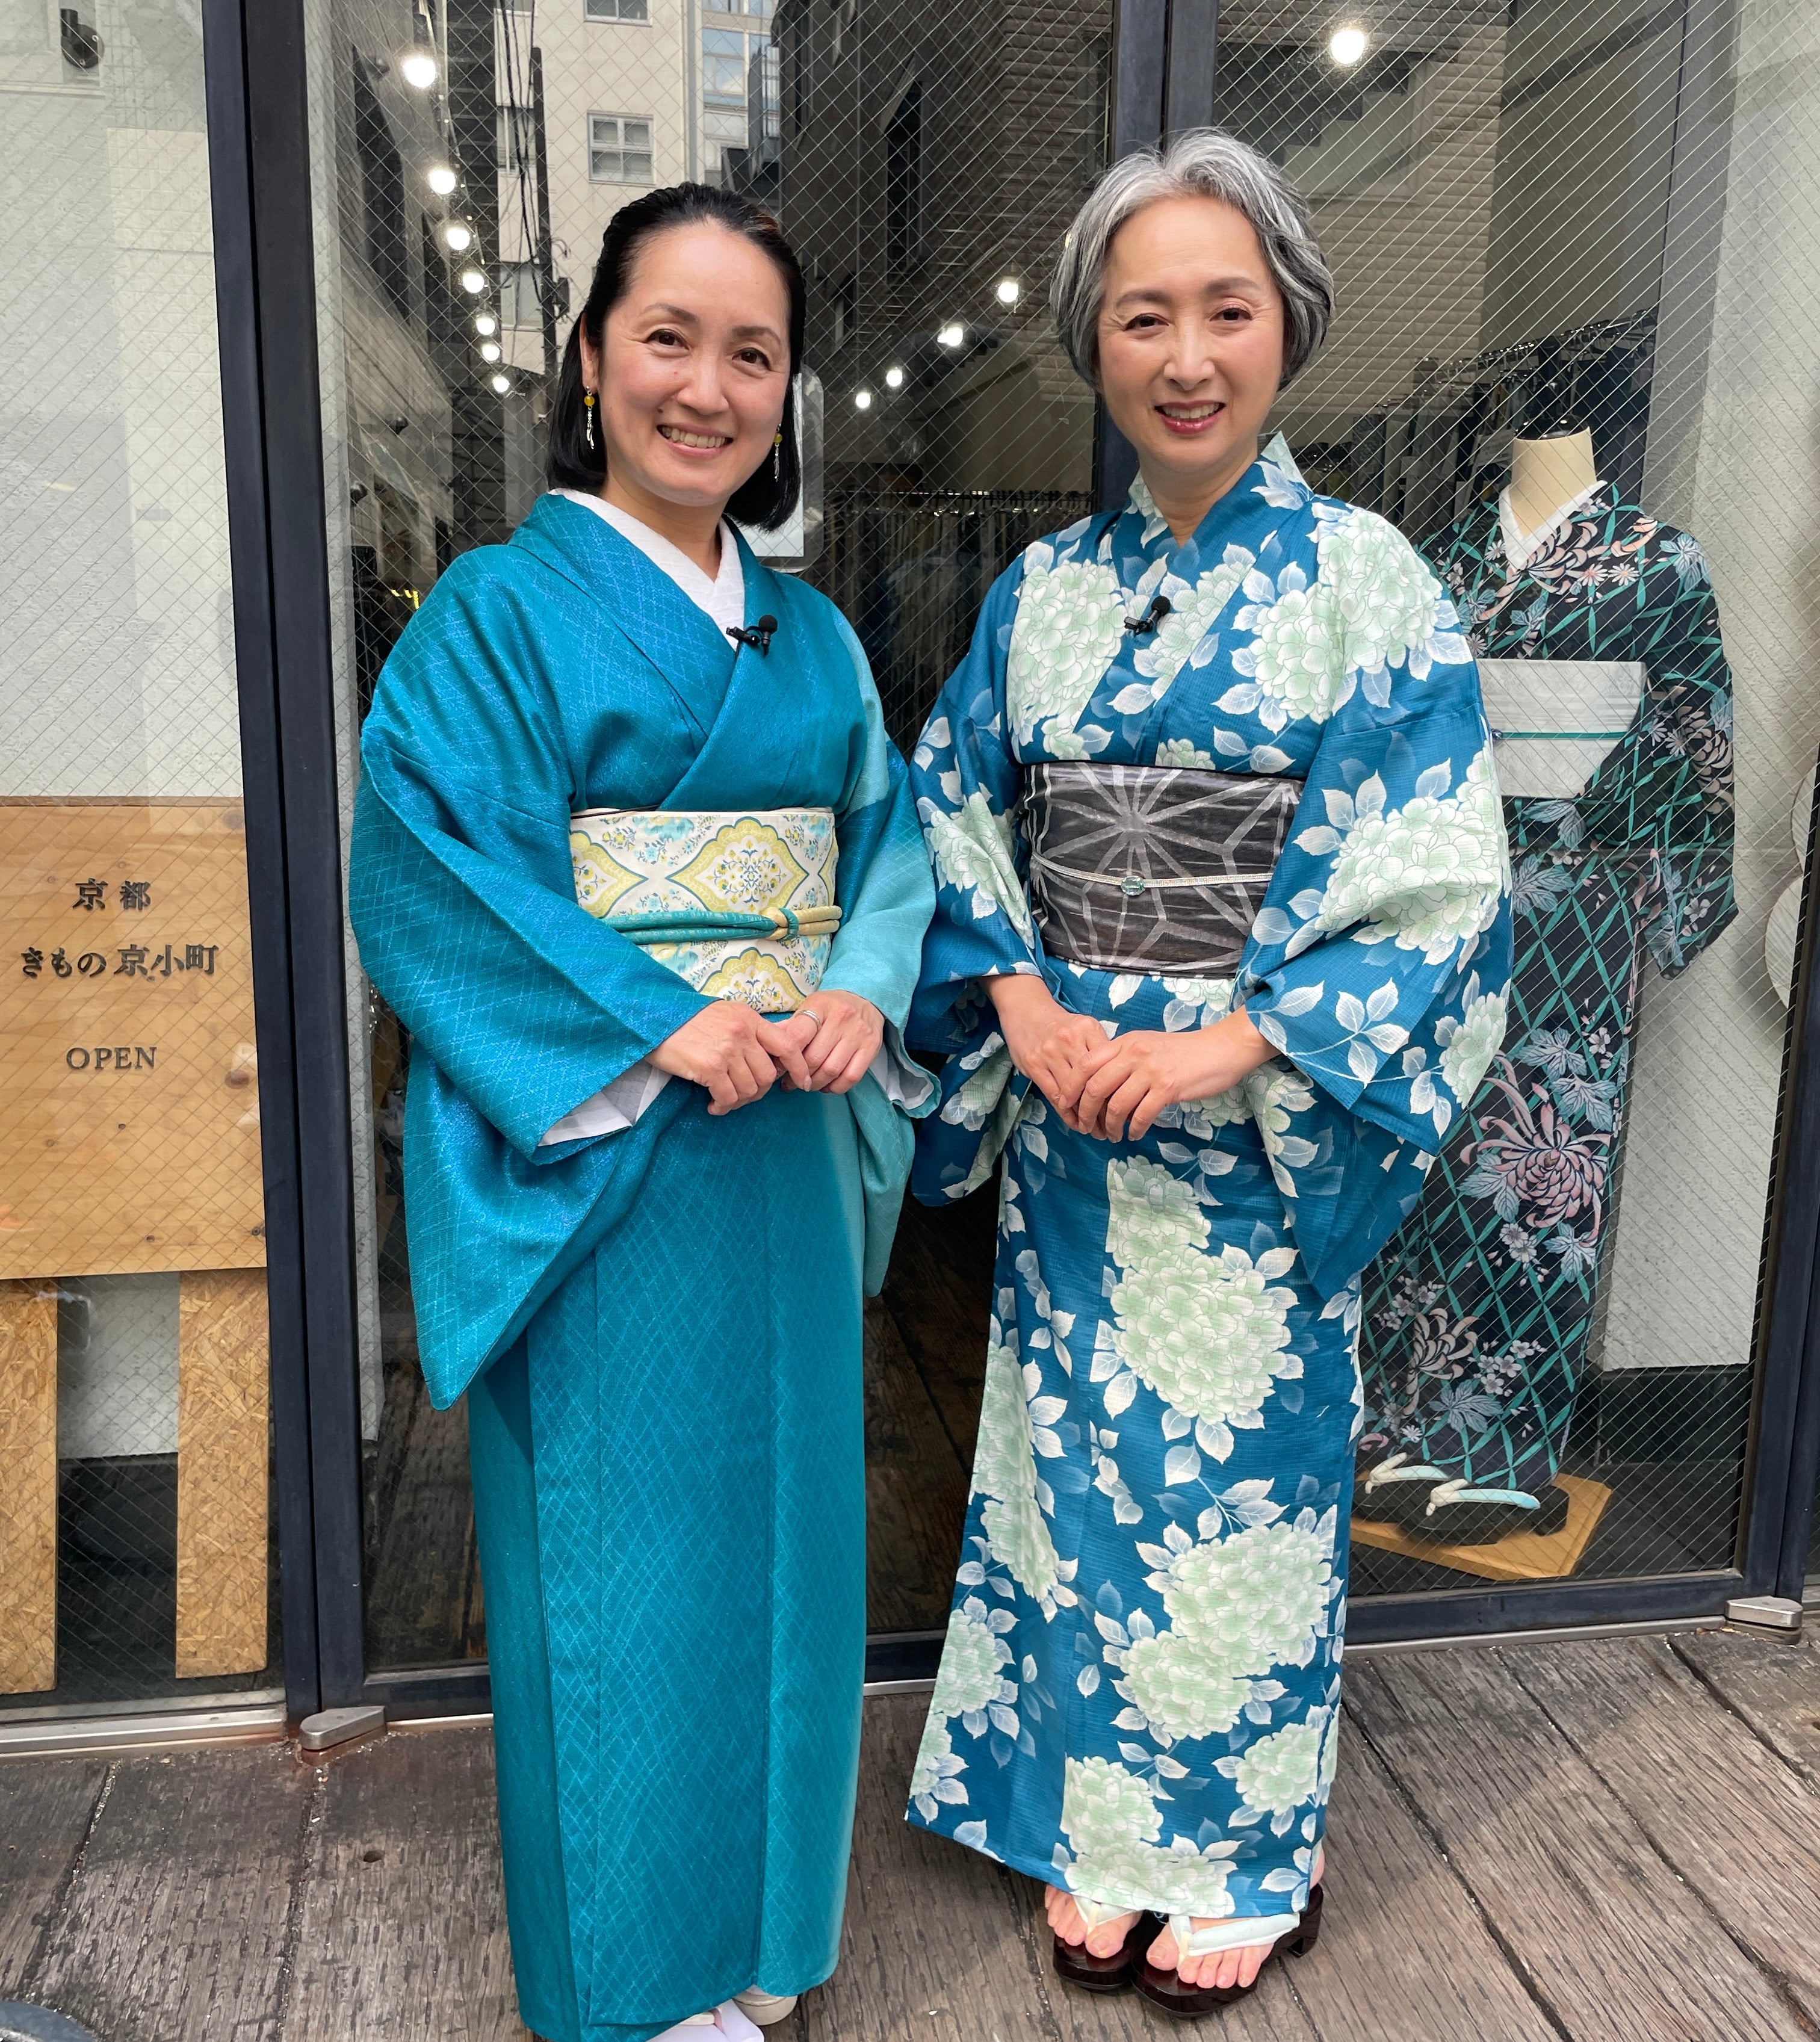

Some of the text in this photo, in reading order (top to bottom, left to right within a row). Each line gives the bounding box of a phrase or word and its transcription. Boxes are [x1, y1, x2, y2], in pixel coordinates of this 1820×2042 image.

[73, 878, 151, 910] 京都
[21, 944, 219, 978] きもの京小町
[66, 1047, 156, 1070] OPEN
